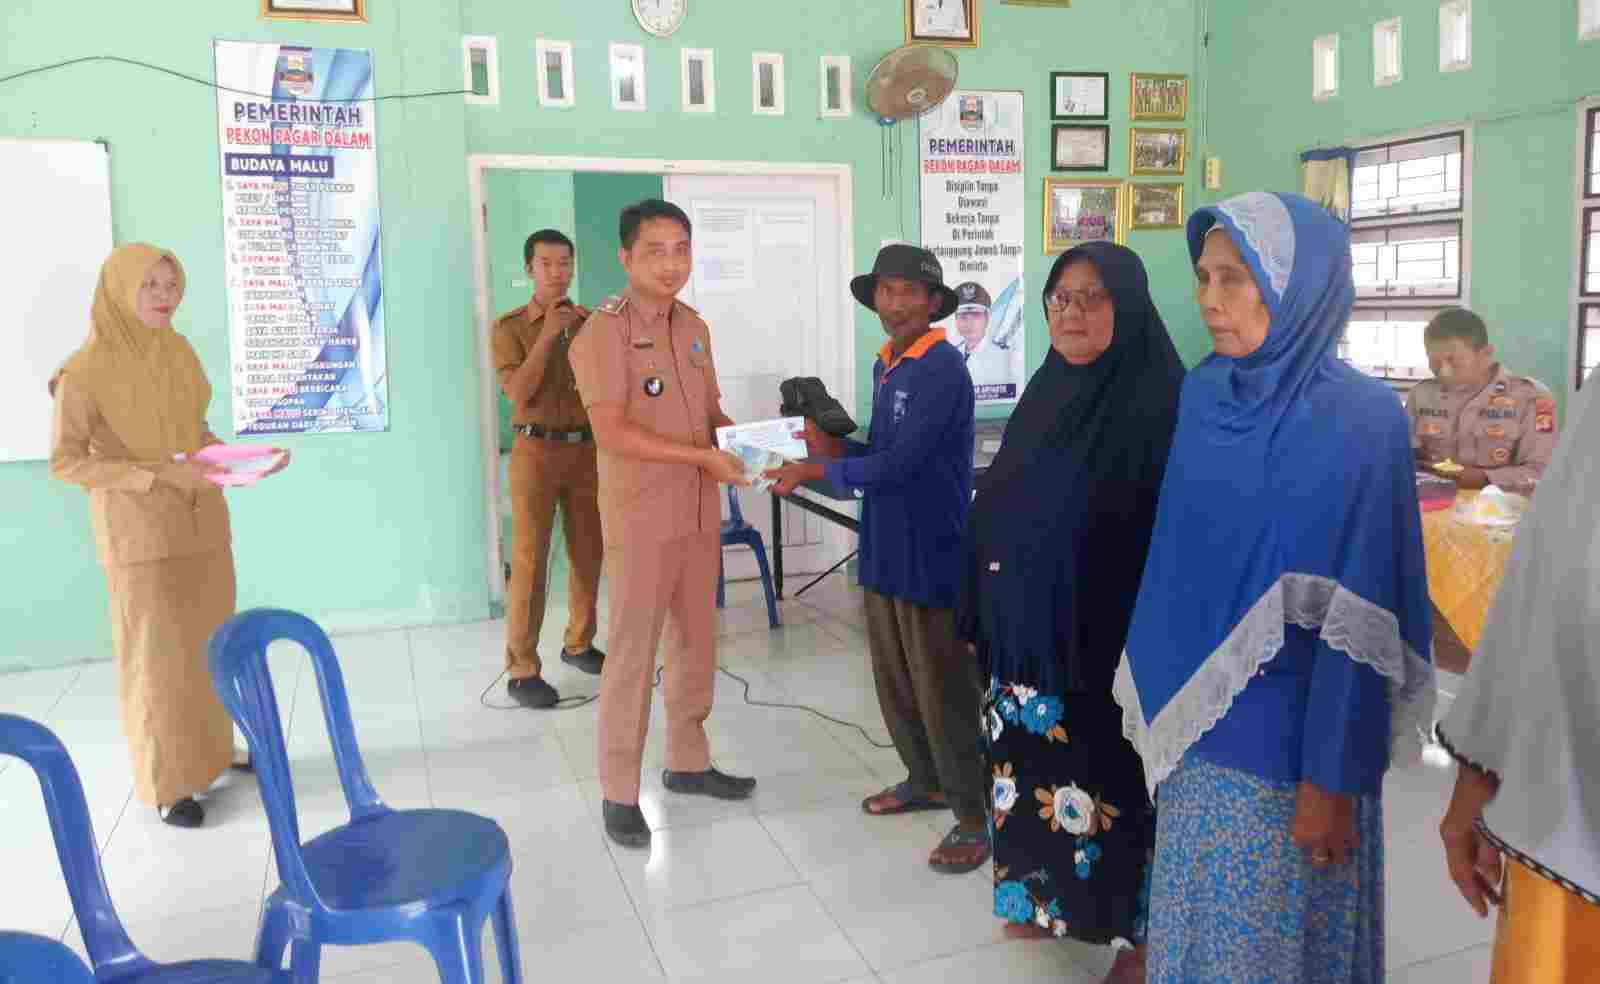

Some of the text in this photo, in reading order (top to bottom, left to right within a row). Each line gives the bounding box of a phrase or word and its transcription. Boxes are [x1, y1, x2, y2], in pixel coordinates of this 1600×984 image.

[234, 102, 361, 123] PEMERINTAH
[275, 130, 320, 146] PAGAR
[324, 132, 370, 148] DALAM
[929, 139, 1014, 153] PEMERINTAH
[231, 158, 329, 173] BUDAYA MALU
[976, 180, 999, 193] Tanpa
[952, 228, 961, 241] Di
